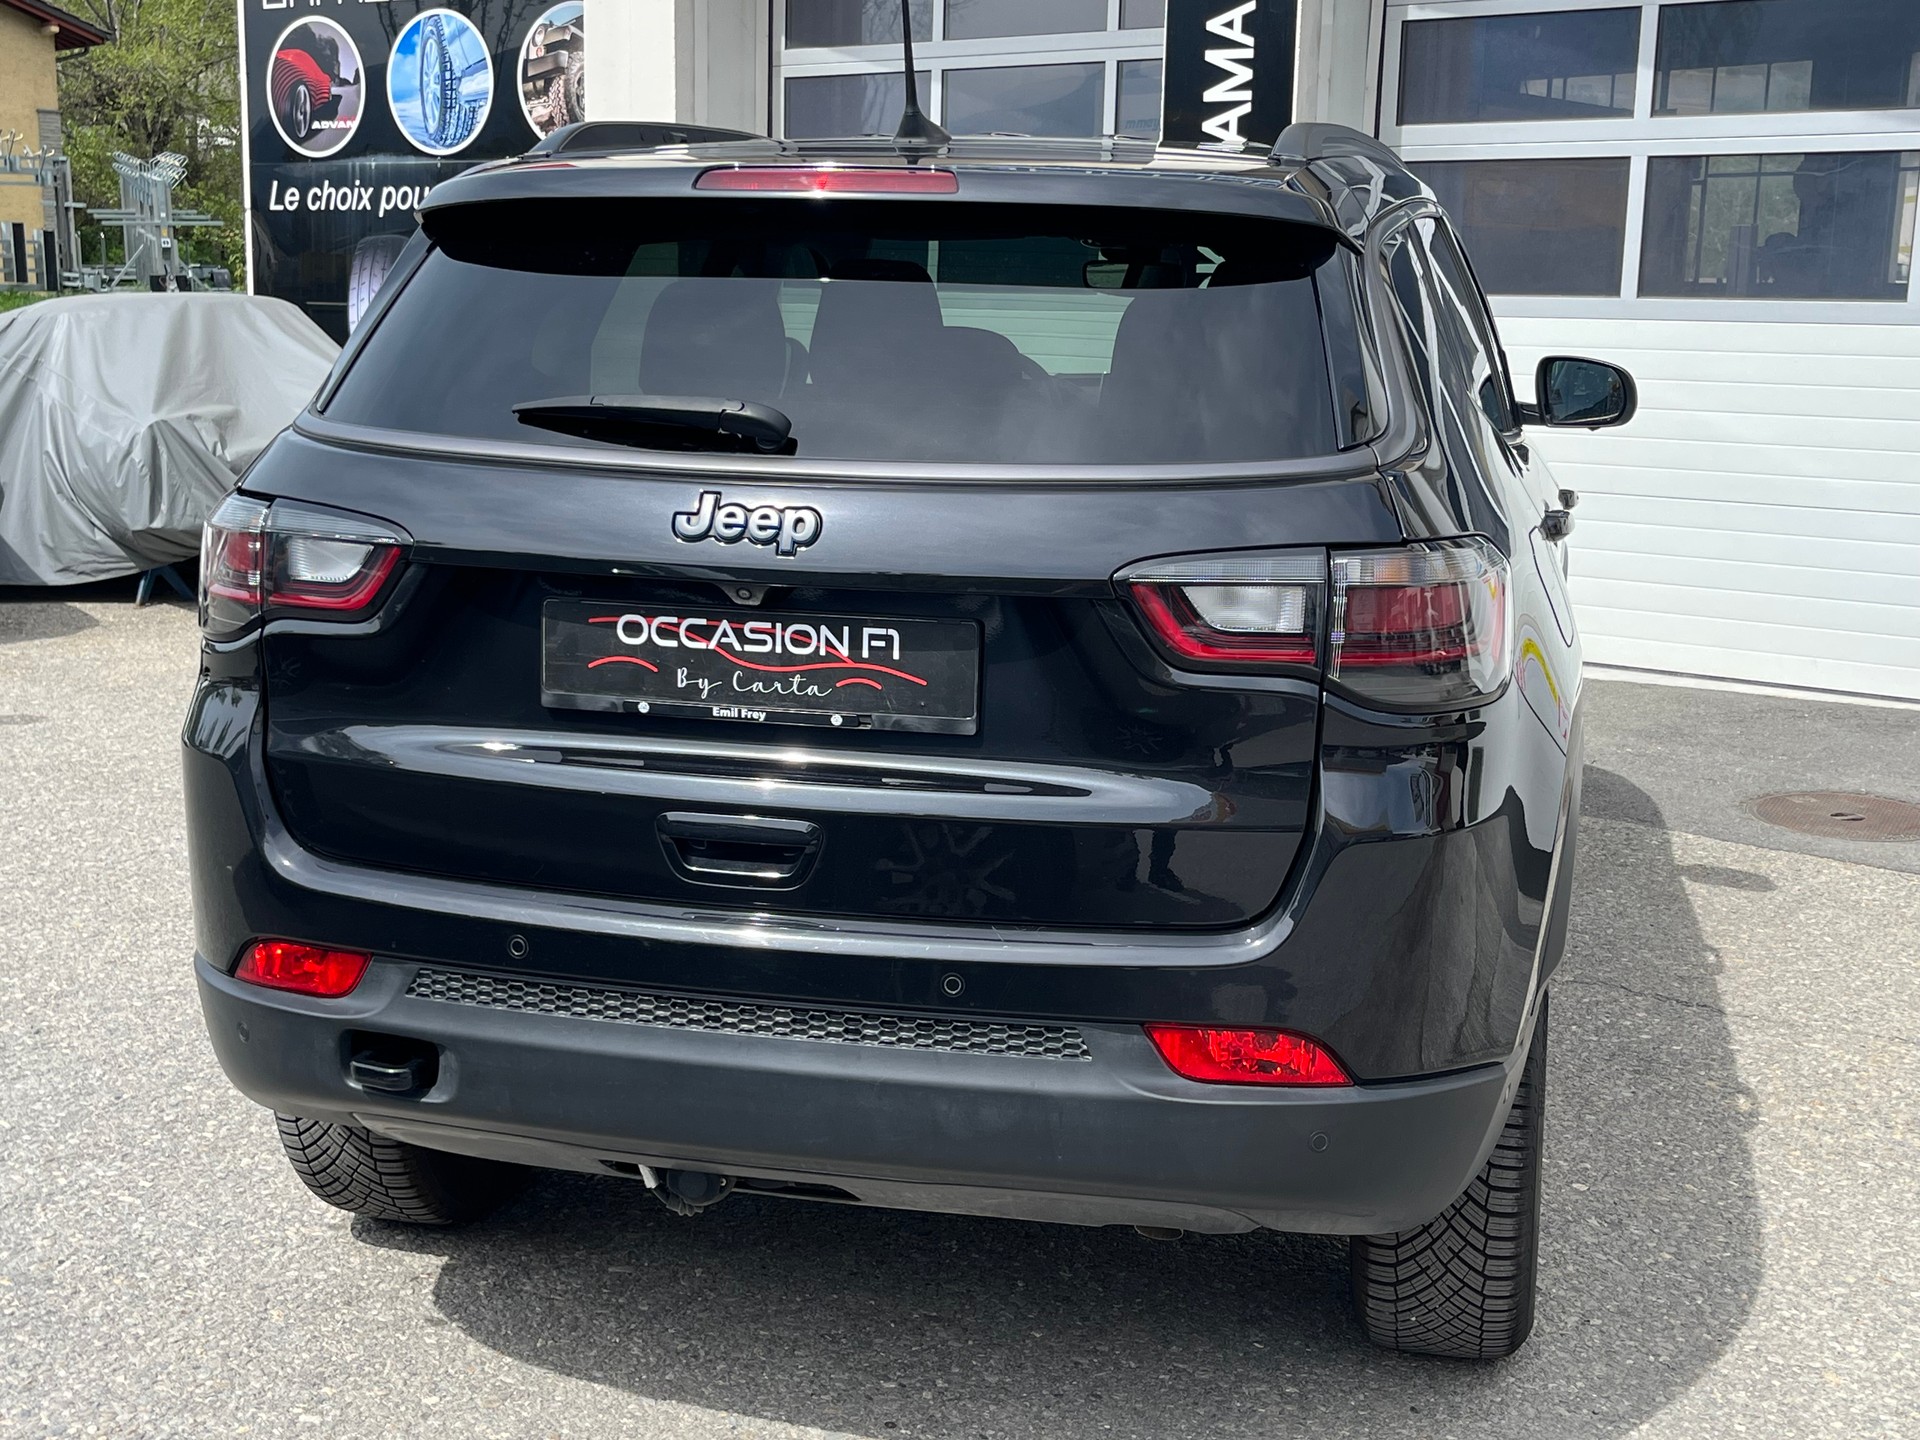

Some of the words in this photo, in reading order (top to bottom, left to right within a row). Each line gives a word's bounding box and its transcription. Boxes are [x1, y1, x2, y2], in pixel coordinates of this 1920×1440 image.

[269, 180, 300, 211] Le
[306, 179, 374, 211] choix
[671, 491, 823, 556] Jeep
[616, 613, 850, 657] OCCASION
[677, 667, 722, 699] By
[732, 670, 832, 697] Carta
[712, 707, 738, 718] Emil
[741, 708, 767, 722] Frey
